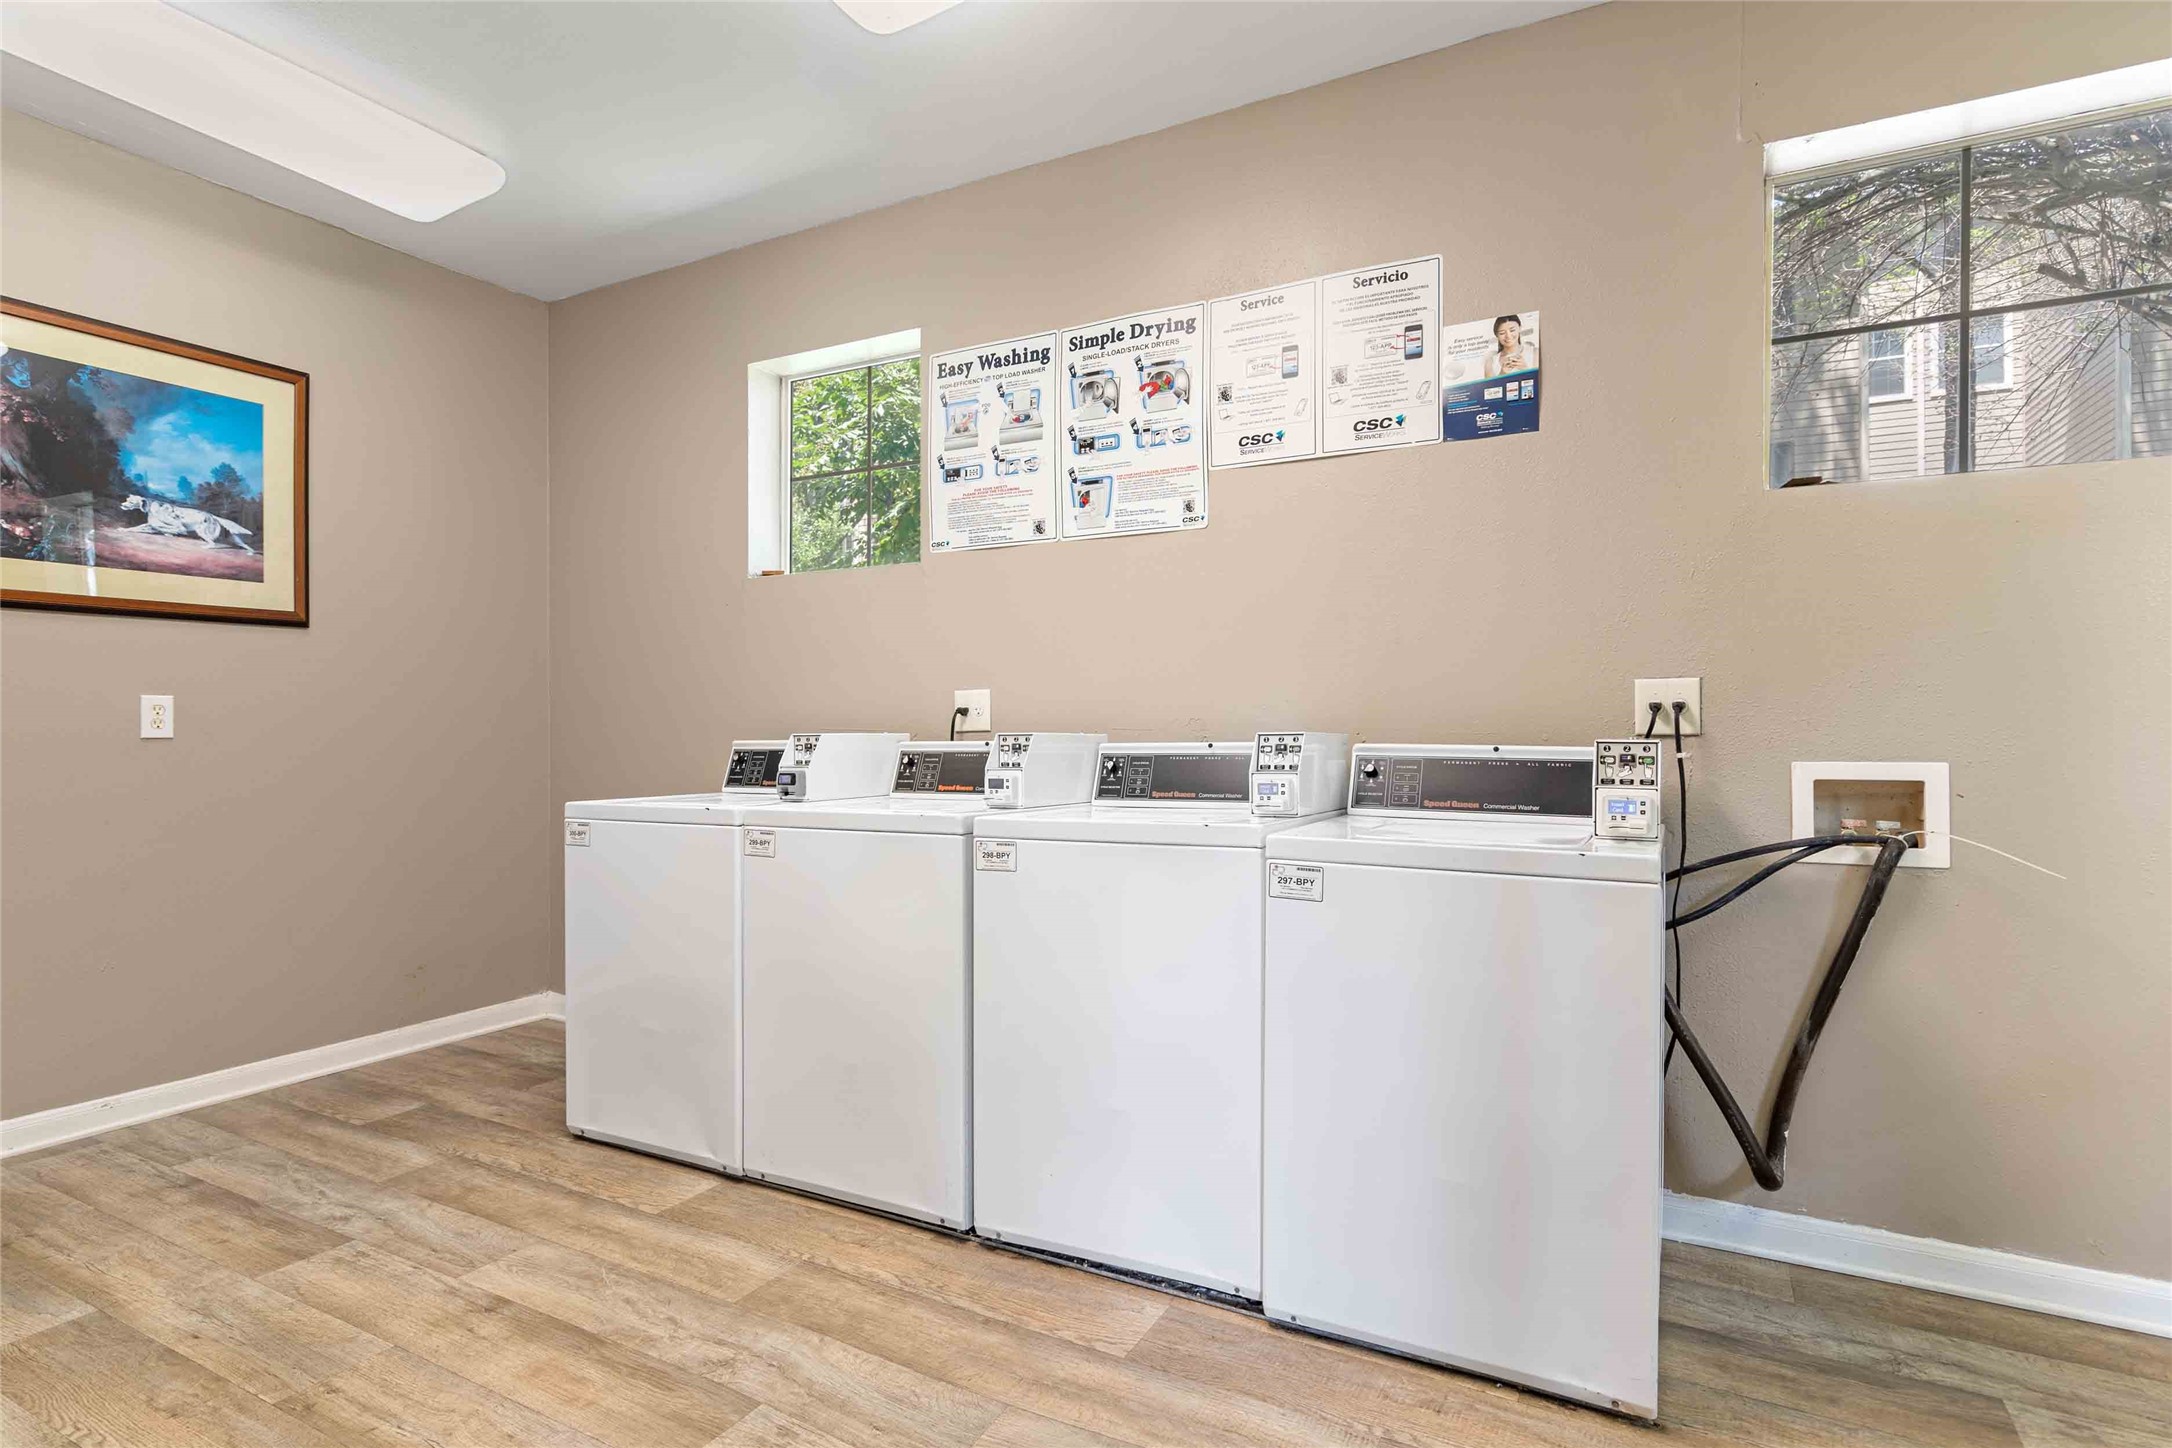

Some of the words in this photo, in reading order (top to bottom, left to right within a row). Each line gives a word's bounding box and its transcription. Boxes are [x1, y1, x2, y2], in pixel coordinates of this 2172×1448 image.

[1353, 270, 1408, 289] Servicio
[1240, 295, 1284, 311] Service
[1069, 327, 1125, 352] Simple
[1129, 317, 1197, 339] Drying
[1082, 344, 1149, 361] SINGLE-LOAD/STACK
[1151, 338, 1180, 348] DRYERS
[937, 361, 973, 379] Easy
[977, 347, 1051, 371] Washing
[939, 377, 983, 390] HIGH-EFFICIENCY
[1004, 371, 1021, 379] LOAD
[1021, 367, 1046, 375] WASHER
[1476, 412, 1497, 420] CSC
[1353, 417, 1393, 432] CSC
[1238, 433, 1274, 447] CSC
[1151, 790, 1173, 799] Speed
[1423, 799, 1451, 808] Speed
[1451, 801, 1479, 809] Queen
[1483, 802, 1517, 810] Commercial
[1277, 876, 1315, 886] 297-BPY
